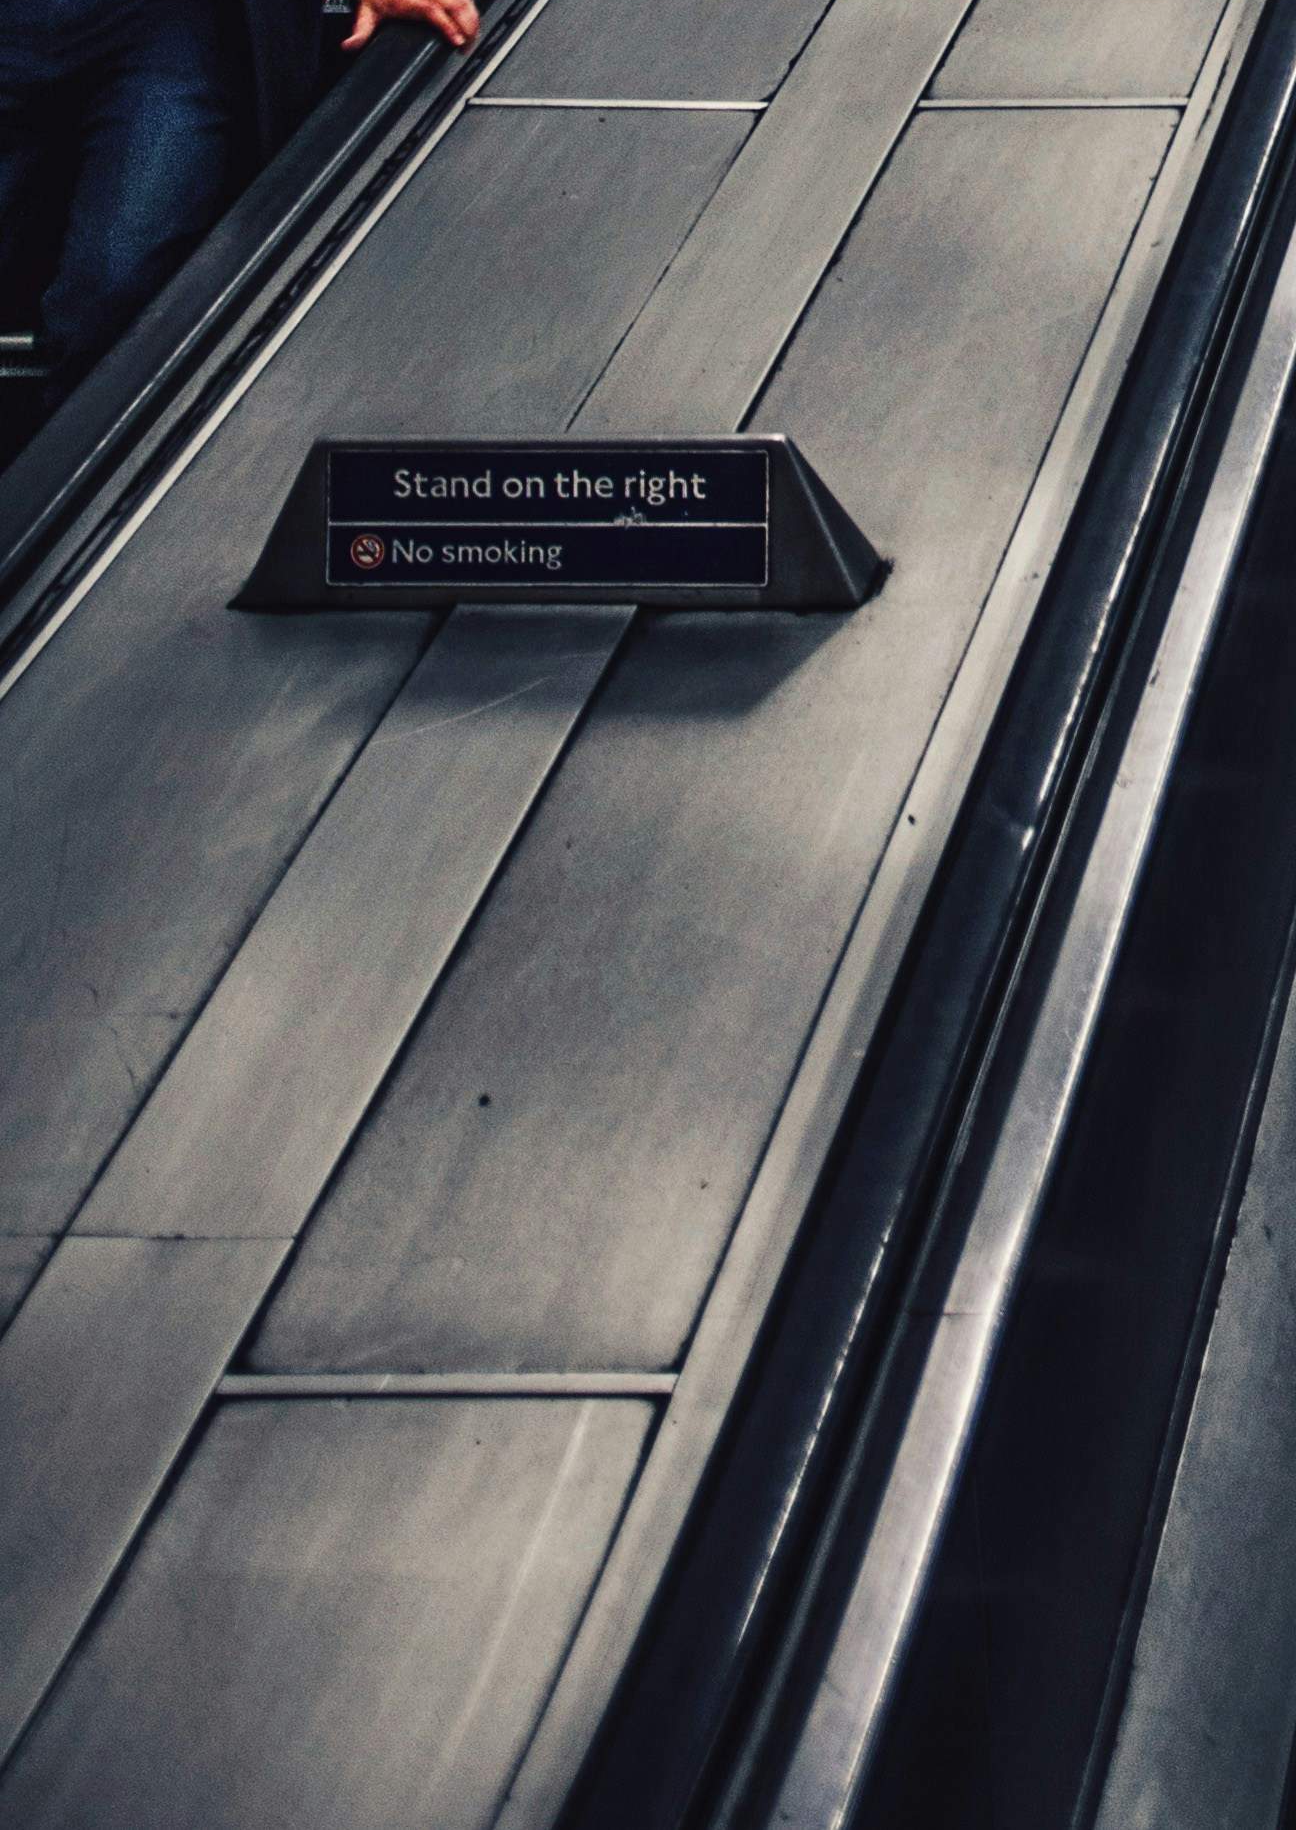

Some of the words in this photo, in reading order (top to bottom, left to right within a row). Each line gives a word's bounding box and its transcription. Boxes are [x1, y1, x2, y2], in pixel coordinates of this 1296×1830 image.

[393, 468, 492, 499] Stand
[502, 477, 545, 499] on
[554, 468, 614, 499] the
[624, 470, 706, 505] right
[392, 539, 433, 564] No
[442, 539, 562, 569] smoking
